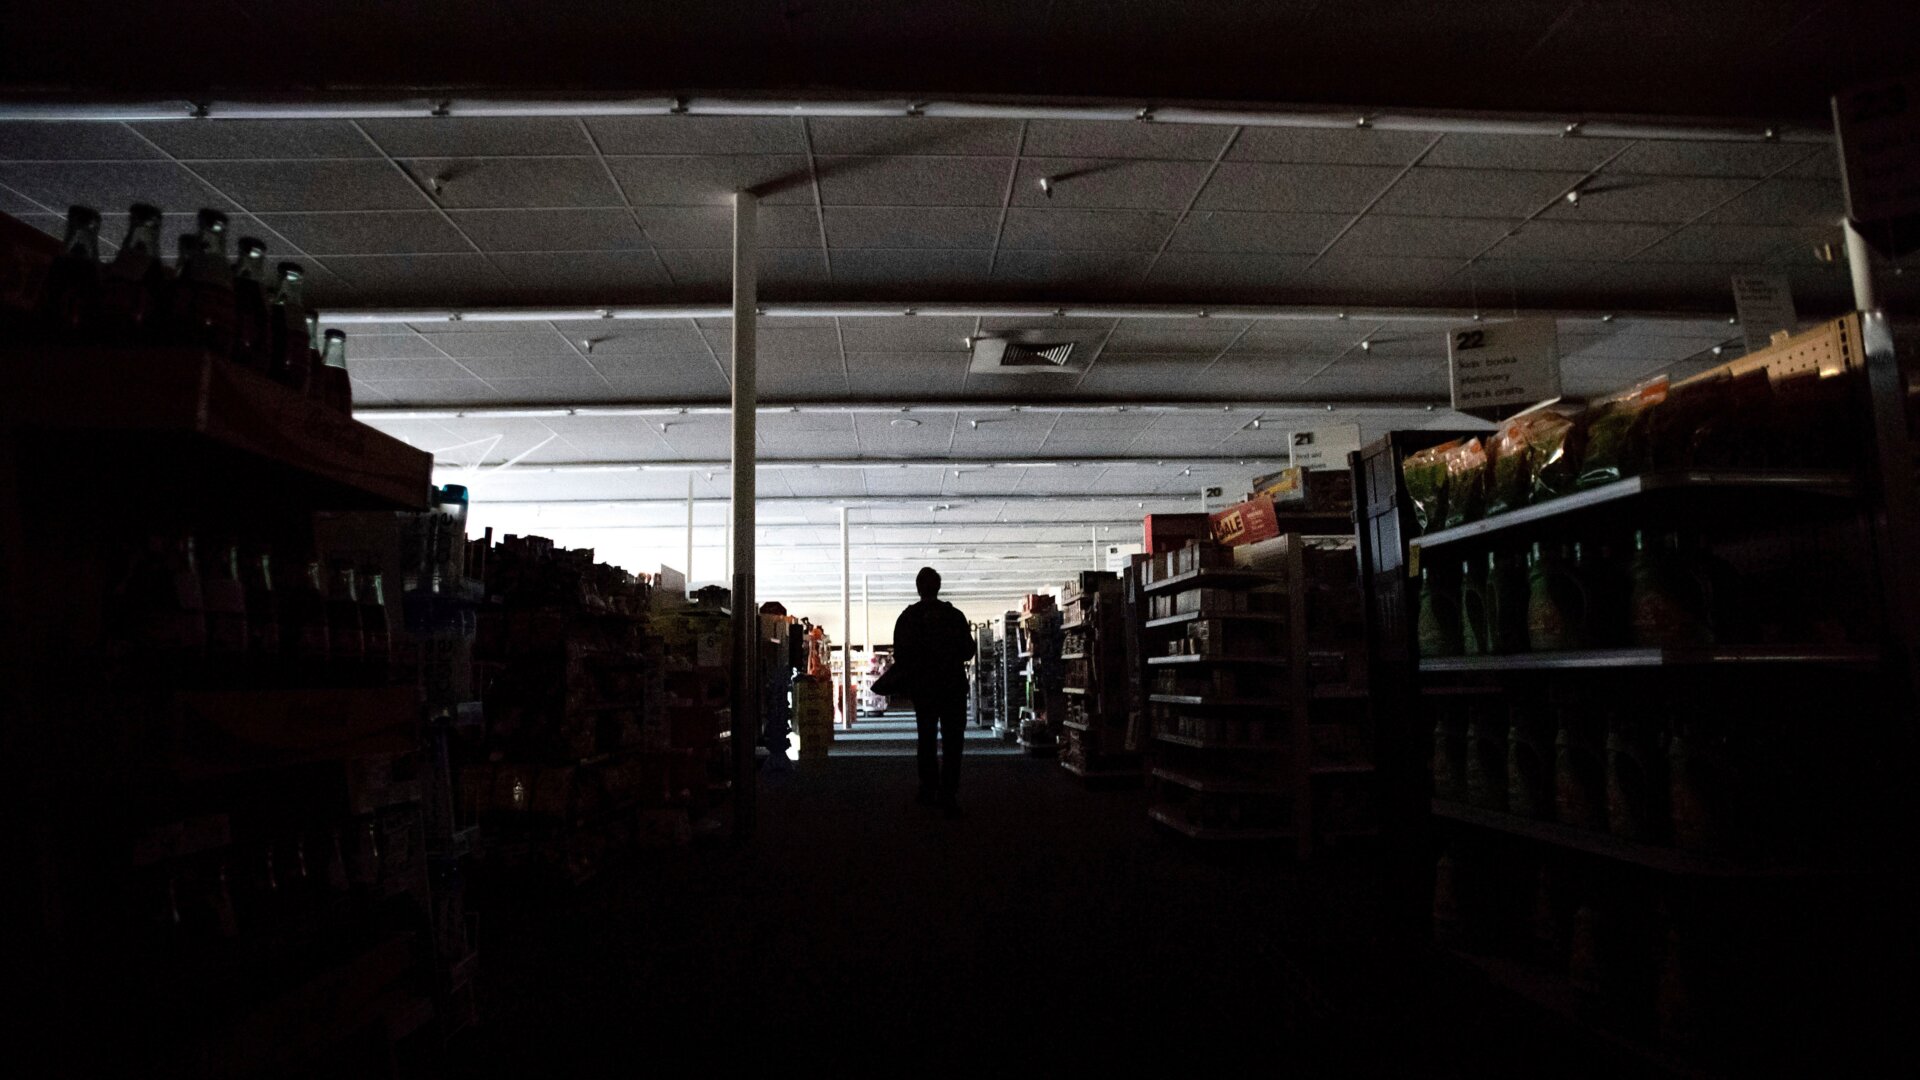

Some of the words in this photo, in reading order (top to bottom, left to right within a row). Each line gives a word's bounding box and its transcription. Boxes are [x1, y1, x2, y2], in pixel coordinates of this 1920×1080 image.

[1456, 330, 1485, 350] 22
[1486, 356, 1518, 366] books
[1460, 374, 1510, 384] stationery
[1461, 390, 1482, 400] arts
[1495, 386, 1524, 397] crafts
[1294, 431, 1314, 446] 21
[1206, 487, 1221, 498] 20
[1213, 515, 1243, 541] SALE
